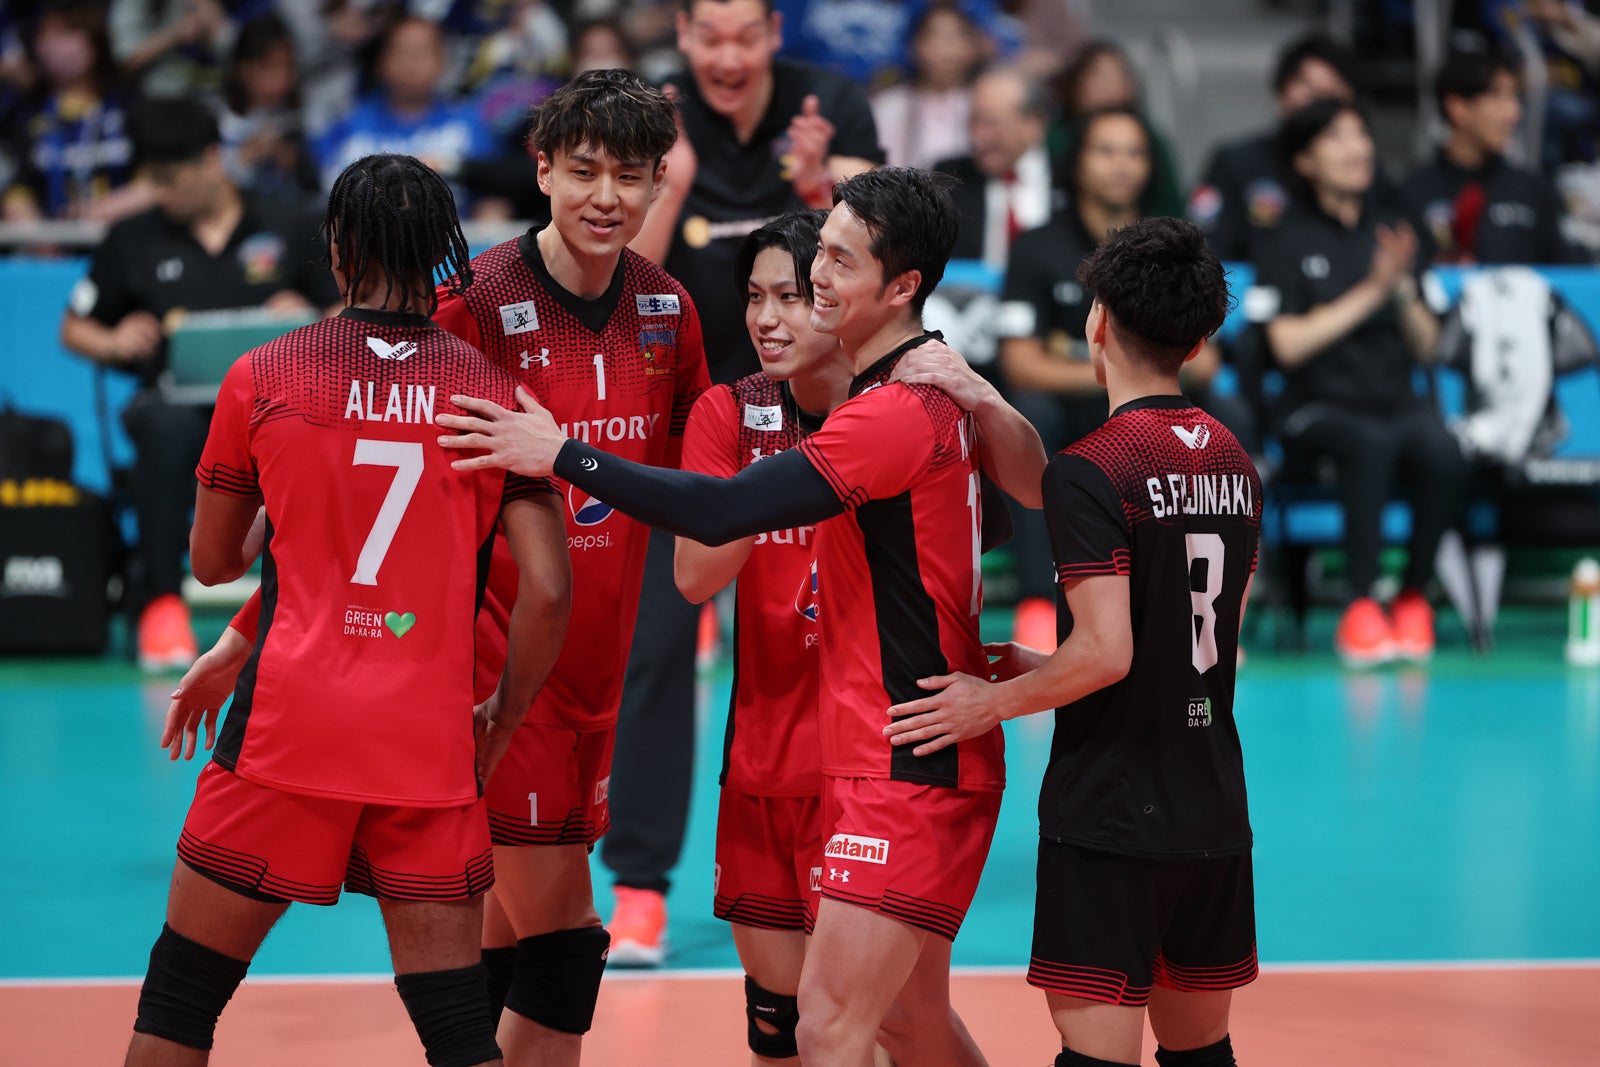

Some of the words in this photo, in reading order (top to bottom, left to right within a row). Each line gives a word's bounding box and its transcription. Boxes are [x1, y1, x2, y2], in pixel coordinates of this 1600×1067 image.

[593, 354, 606, 400] 1
[344, 379, 436, 425] ALAIN
[560, 413, 660, 444] NTORY
[350, 438, 425, 586] 7
[345, 610, 382, 627] GREEN
[528, 792, 538, 826] 1
